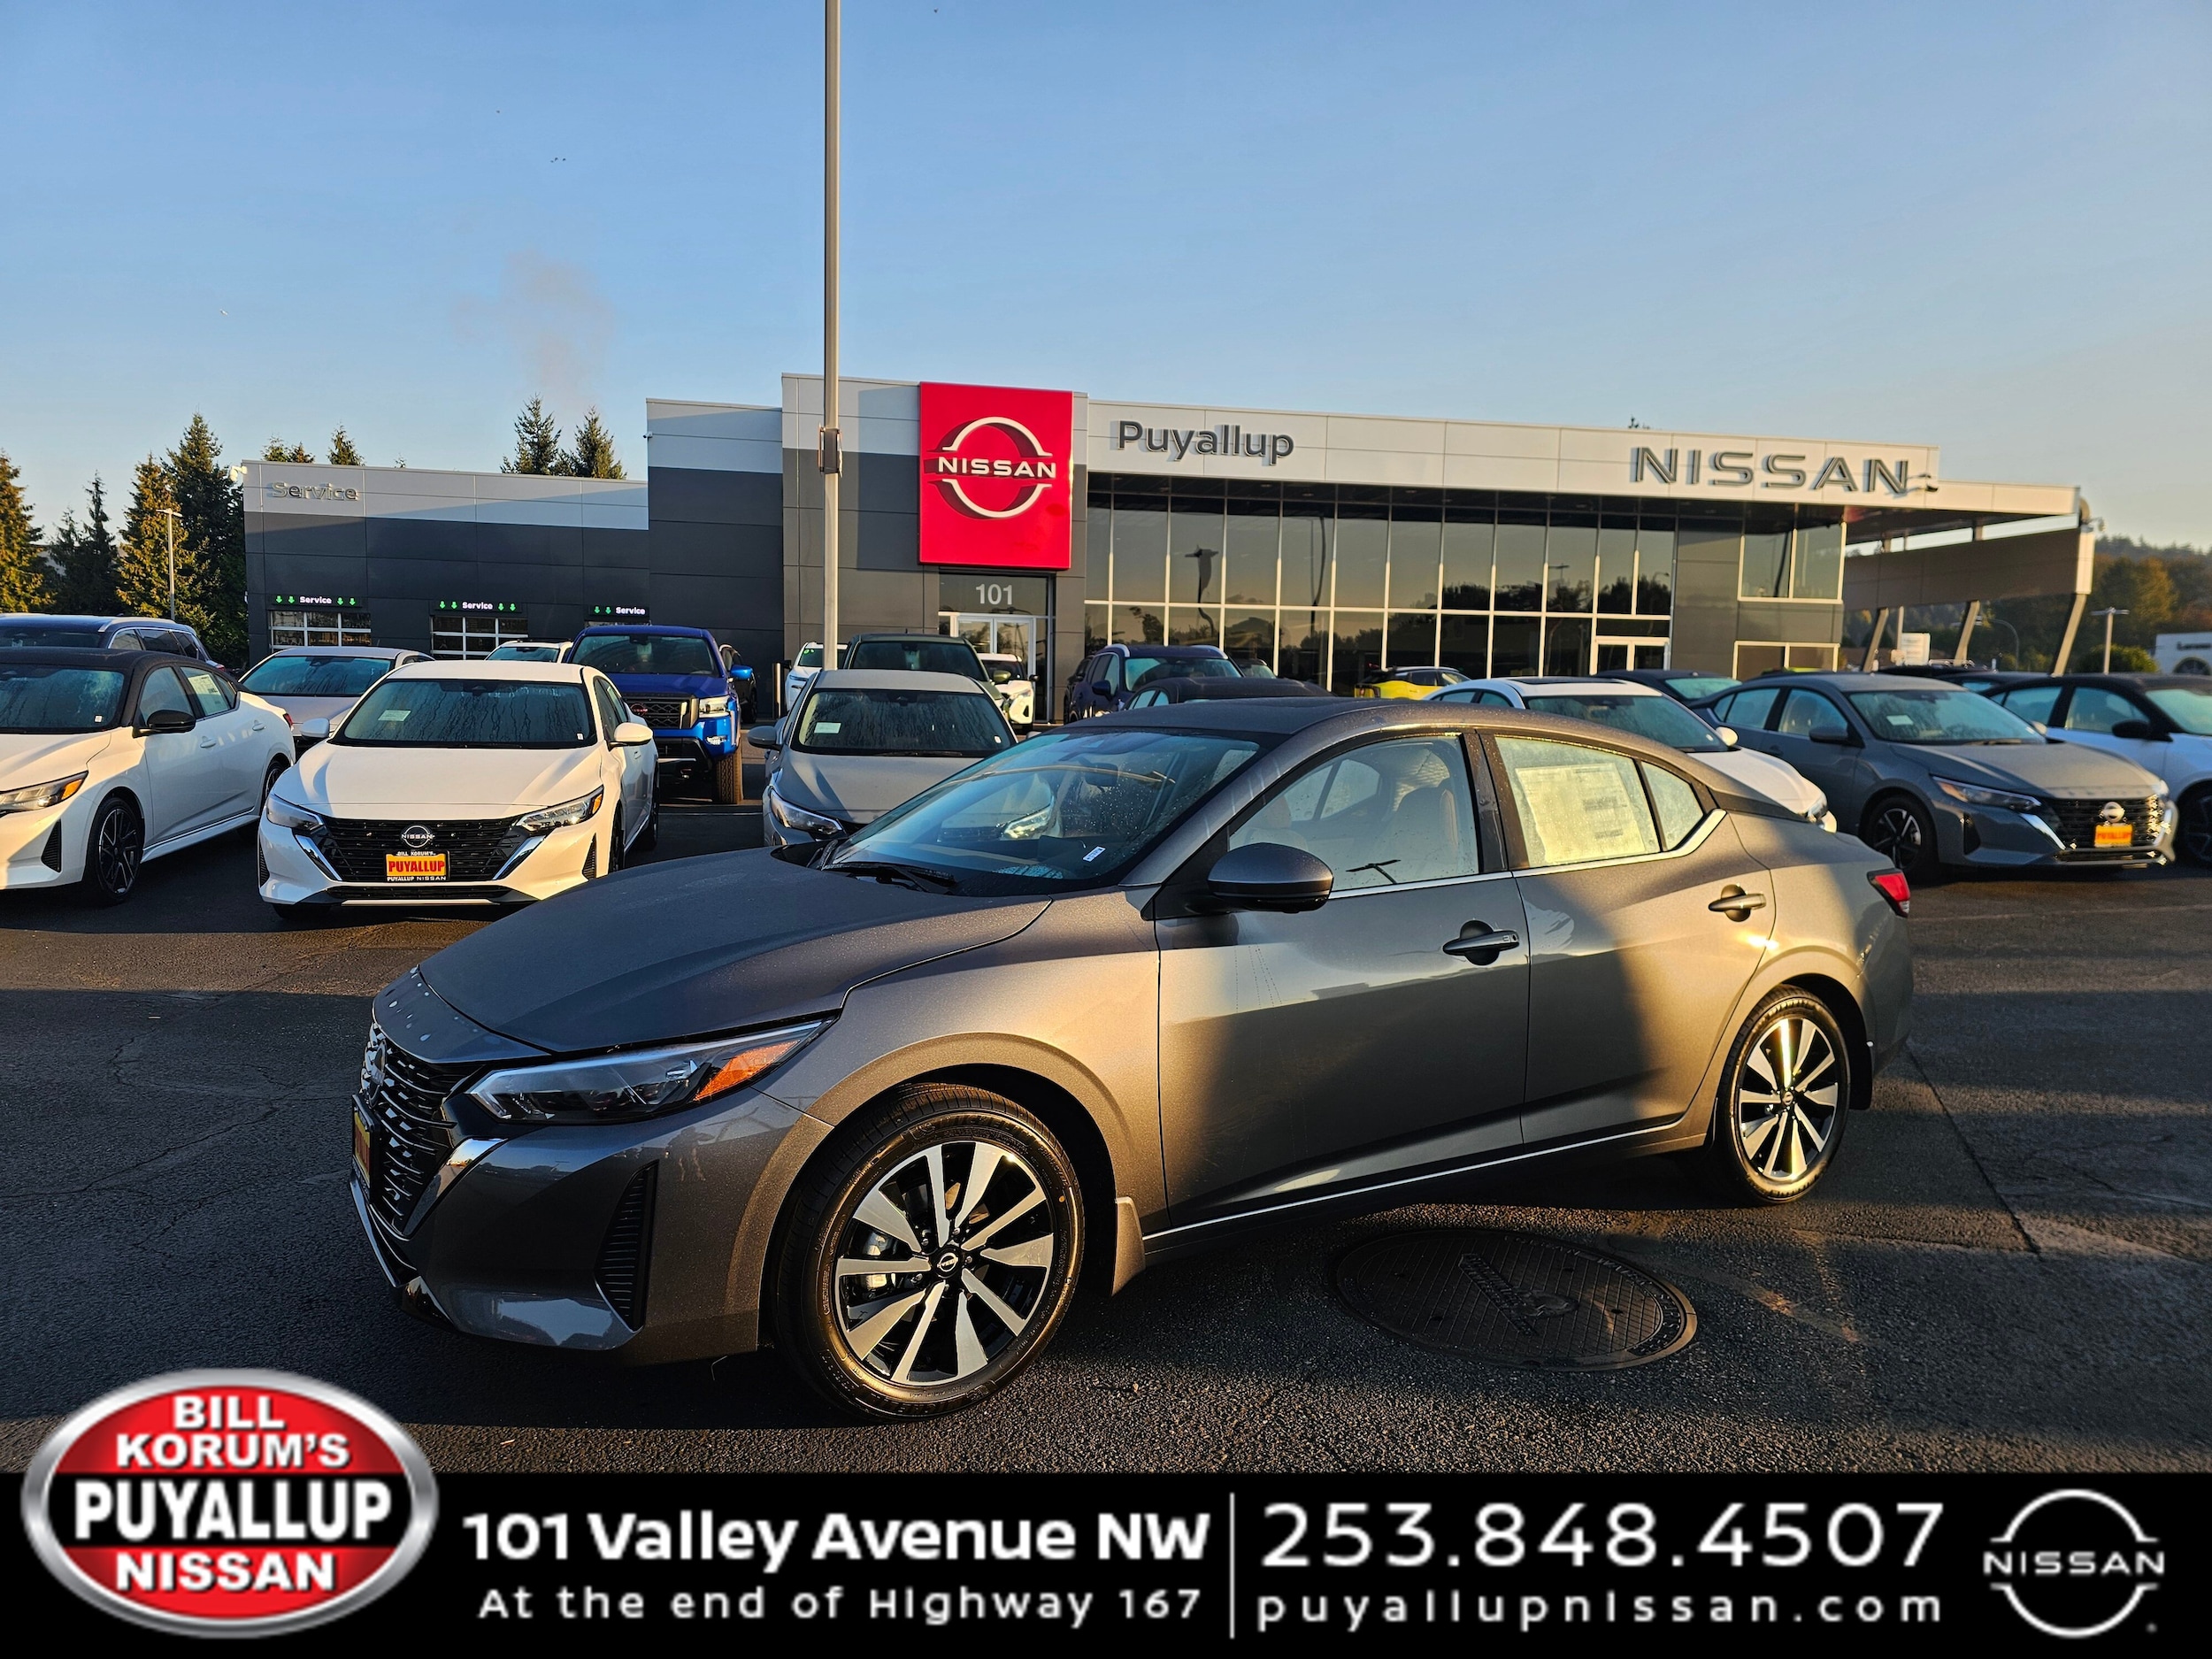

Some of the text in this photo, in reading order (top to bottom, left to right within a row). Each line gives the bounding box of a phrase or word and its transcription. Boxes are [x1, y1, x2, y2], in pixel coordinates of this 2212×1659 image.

[1118, 420, 1294, 465] Puyallup
[938, 456, 1056, 479] NISSAN
[1633, 446, 1909, 495] NISSAN
[271, 481, 359, 501] Service
[299, 595, 333, 604] Service
[975, 583, 1012, 605] 101
[388, 860, 445, 872] PUYALLUP
